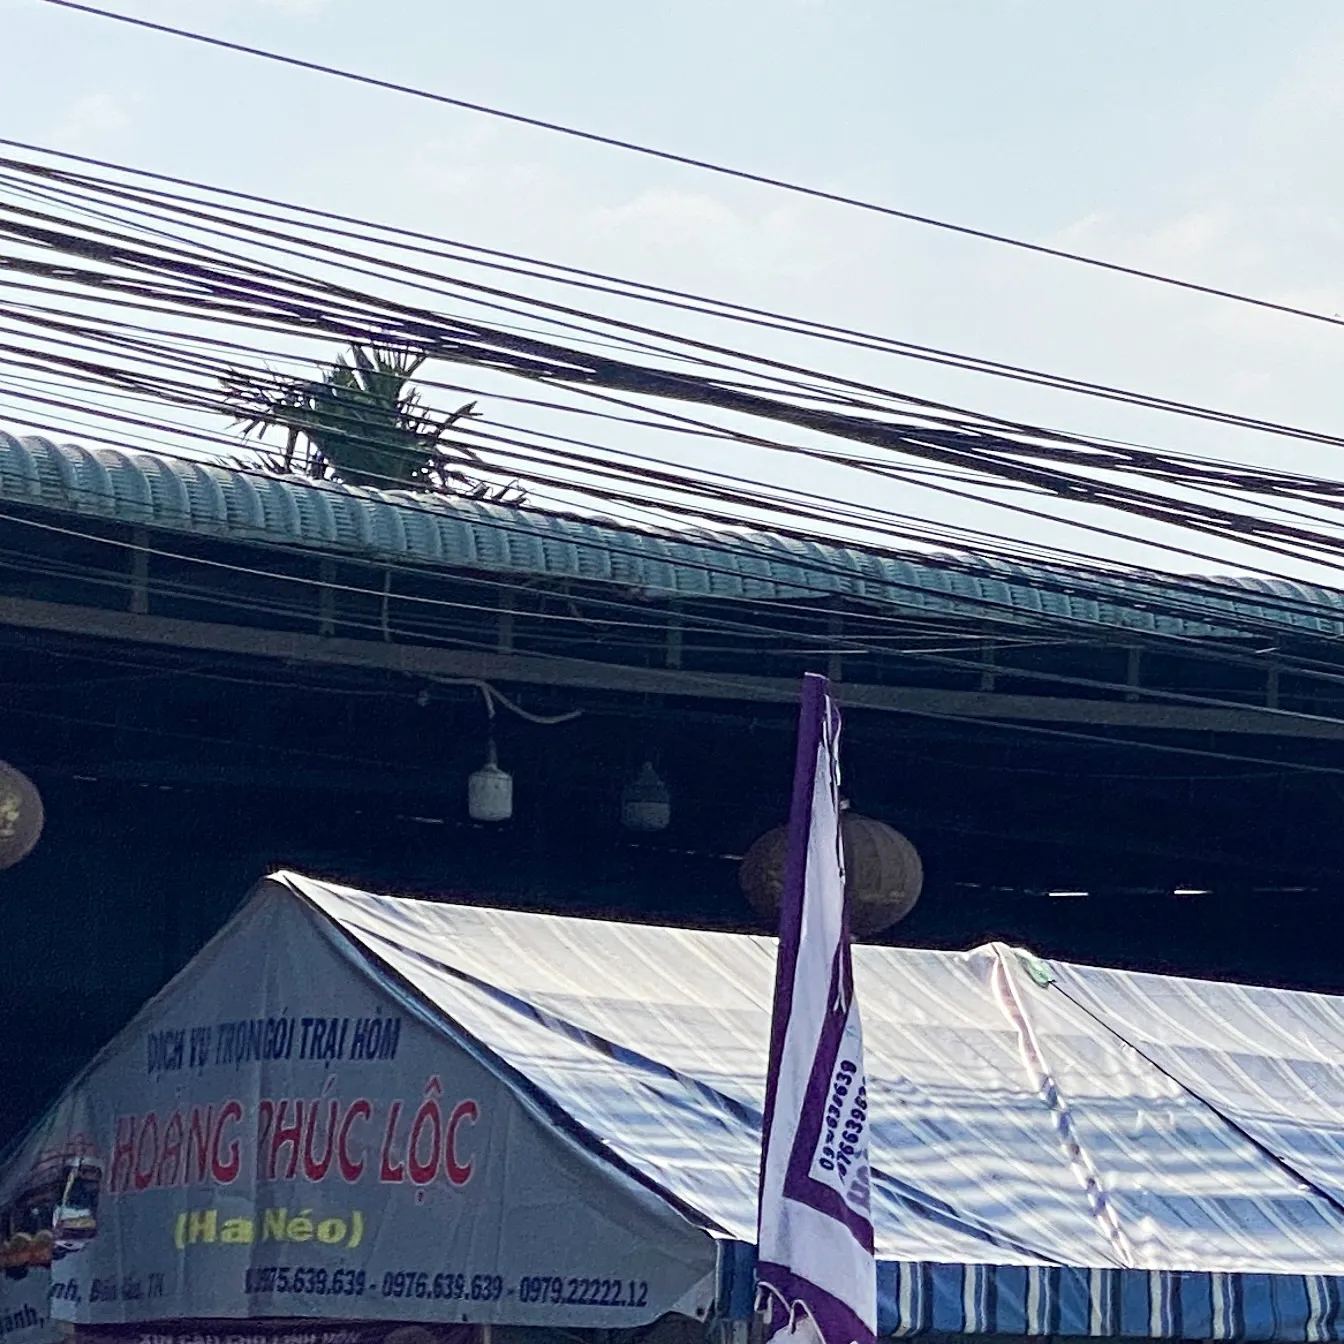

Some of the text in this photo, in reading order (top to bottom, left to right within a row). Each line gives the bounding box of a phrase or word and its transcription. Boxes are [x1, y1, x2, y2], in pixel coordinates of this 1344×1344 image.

[300, 1018, 346, 1070] TRẠI
[379, 1074, 481, 1204] LỘC
[382, 1270, 503, 1301] 0976.639.639
